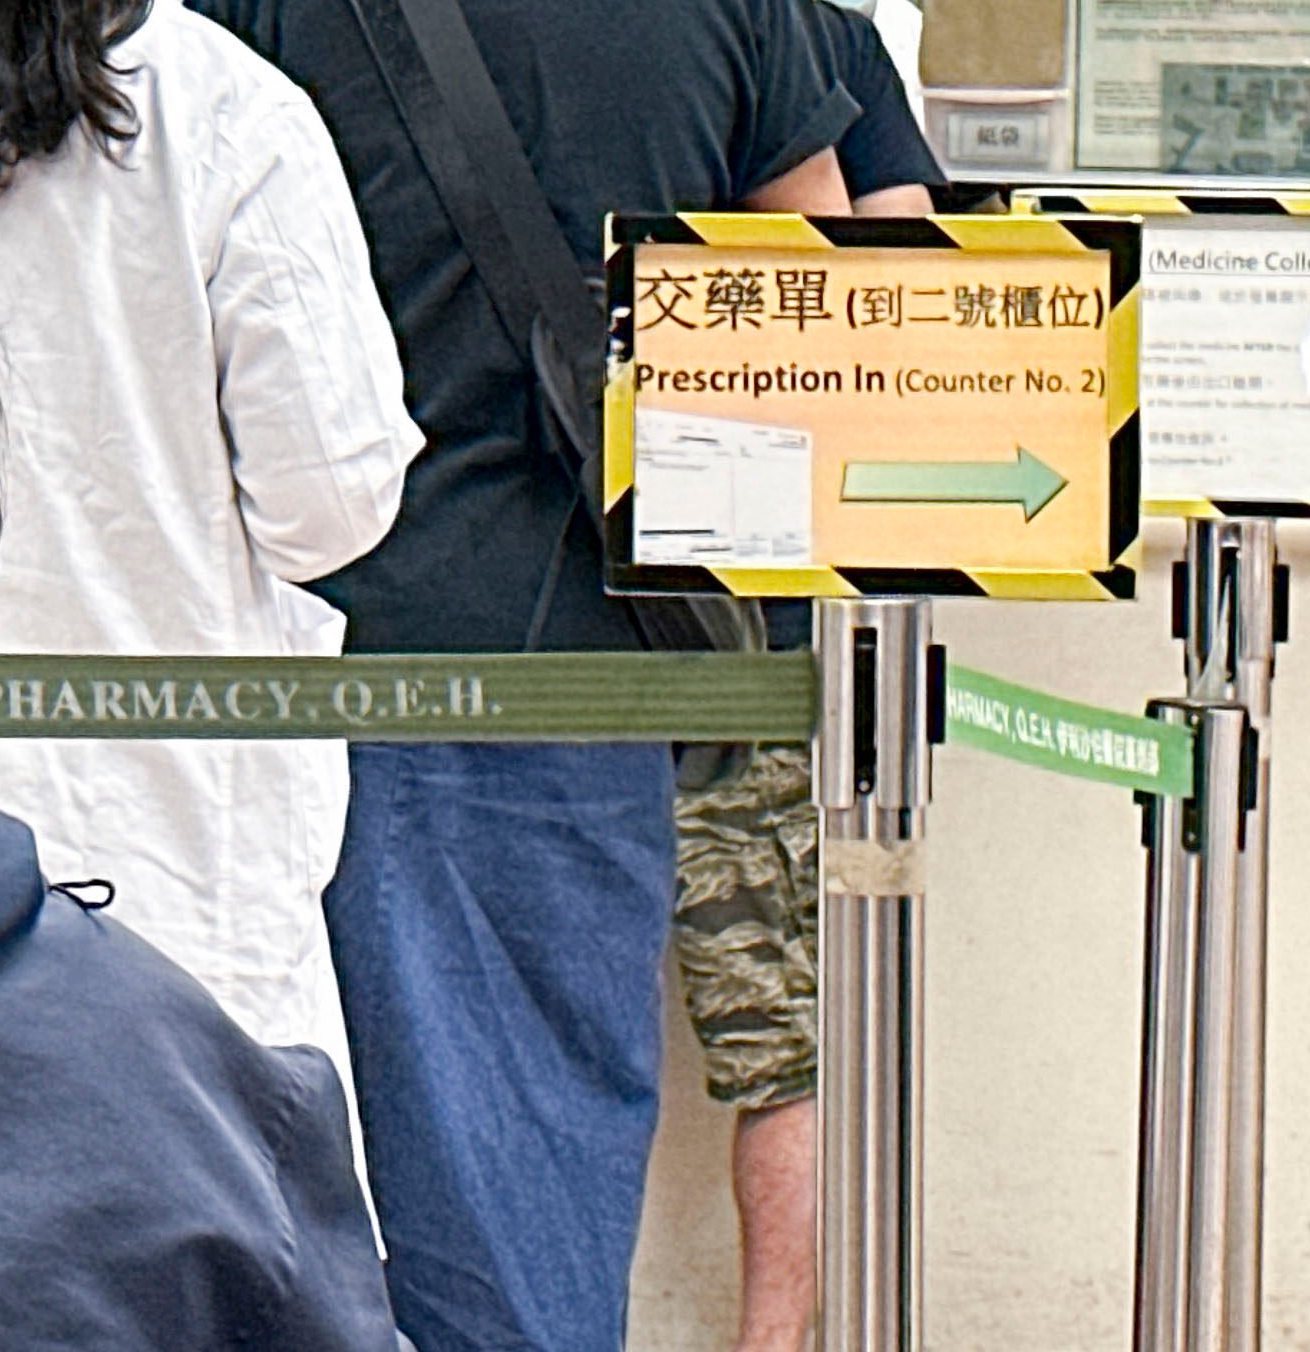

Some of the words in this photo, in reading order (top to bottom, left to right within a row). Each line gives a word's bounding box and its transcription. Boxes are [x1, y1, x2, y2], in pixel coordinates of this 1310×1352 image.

[1148, 250, 1259, 272] (Medicine
[636, 268, 833, 332] 交藥單
[847, 284, 1104, 330] (到二號櫃位)
[637, 363, 841, 398] Prescription
[855, 364, 884, 392] In
[896, 369, 1015, 397] (Counter
[1026, 369, 1070, 392] No.
[1081, 369, 1105, 397] 2)
[331, 676, 505, 722] Q.E.H.
[946, 687, 1016, 744] HARMACY,
